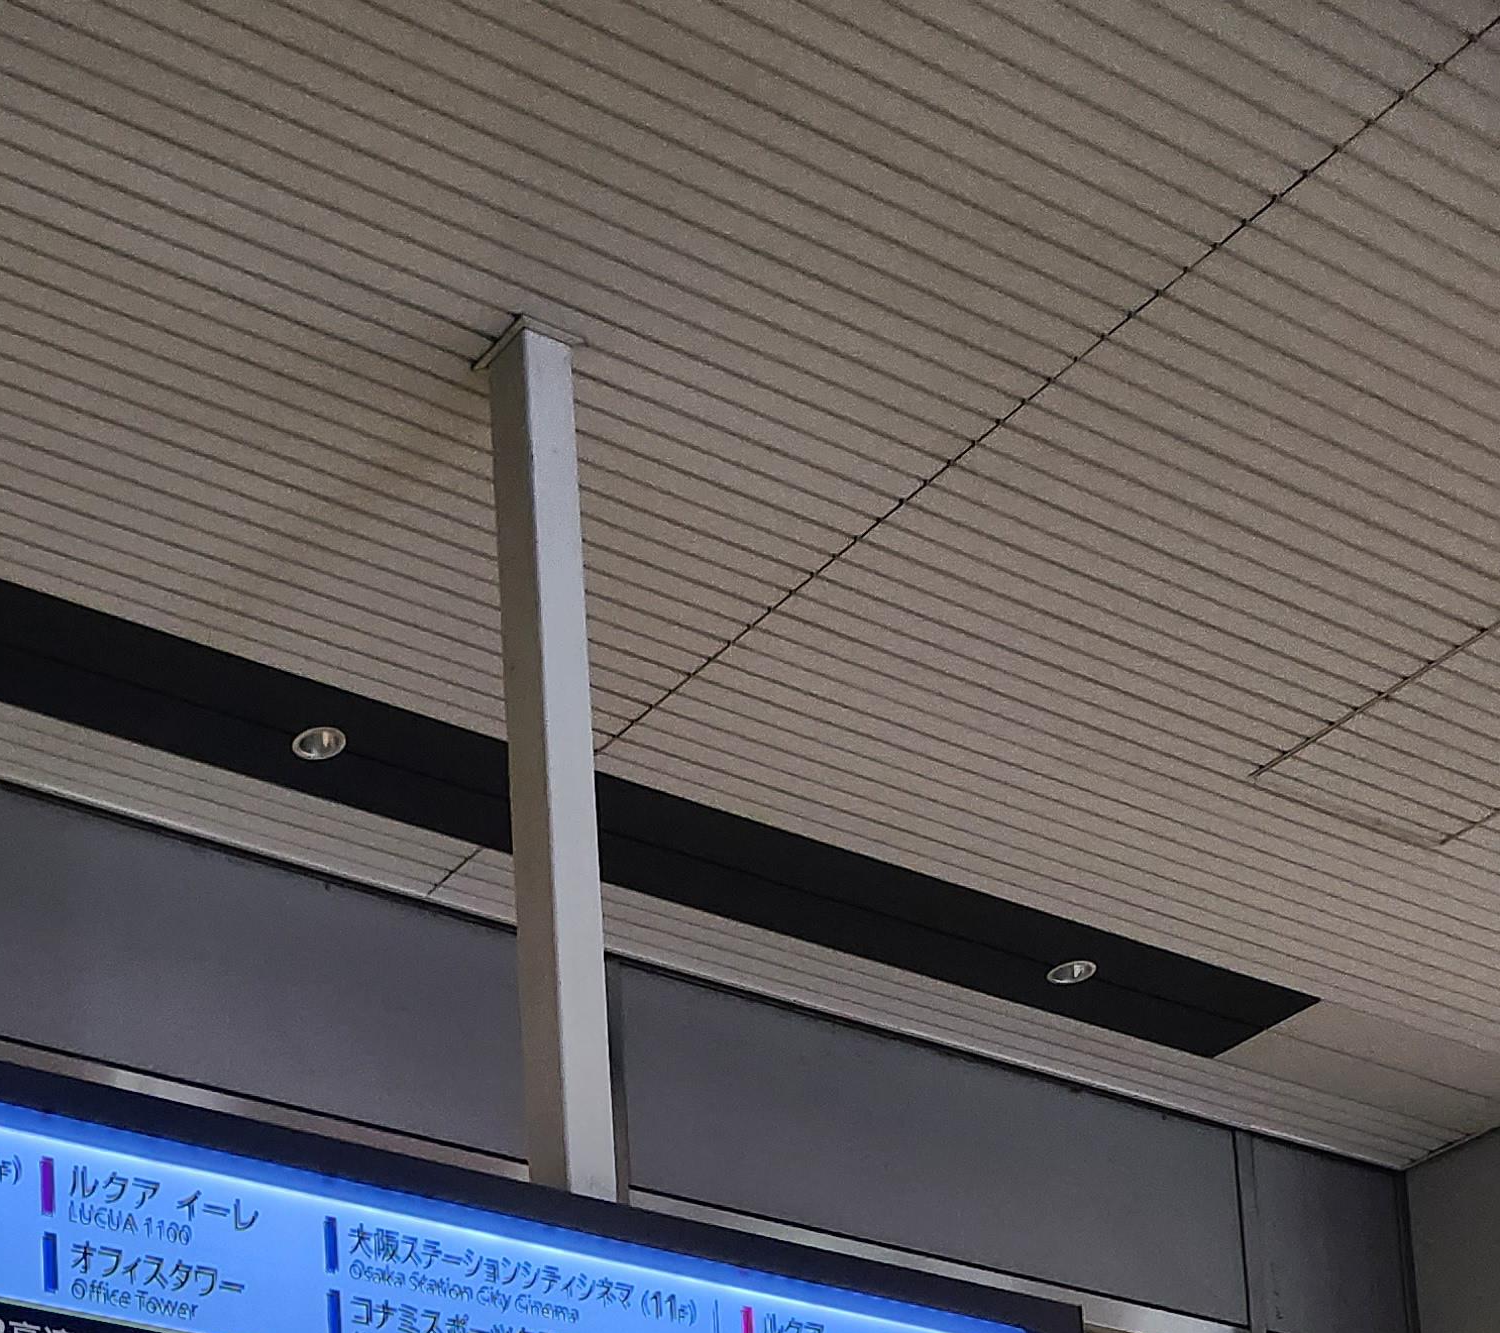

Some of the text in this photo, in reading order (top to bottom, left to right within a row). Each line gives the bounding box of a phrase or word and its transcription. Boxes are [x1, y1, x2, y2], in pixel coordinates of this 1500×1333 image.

[70, 1166, 160, 1208] ルクア
[68, 1201, 192, 1245] LUCUA 1100
[71, 1240, 245, 1296] オフィスタワー
[71, 1278, 198, 1321] Office Tower
[409, 1271, 473, 1301] Station
[476, 1286, 510, 1313] City
[514, 1294, 579, 1323] Cinema
